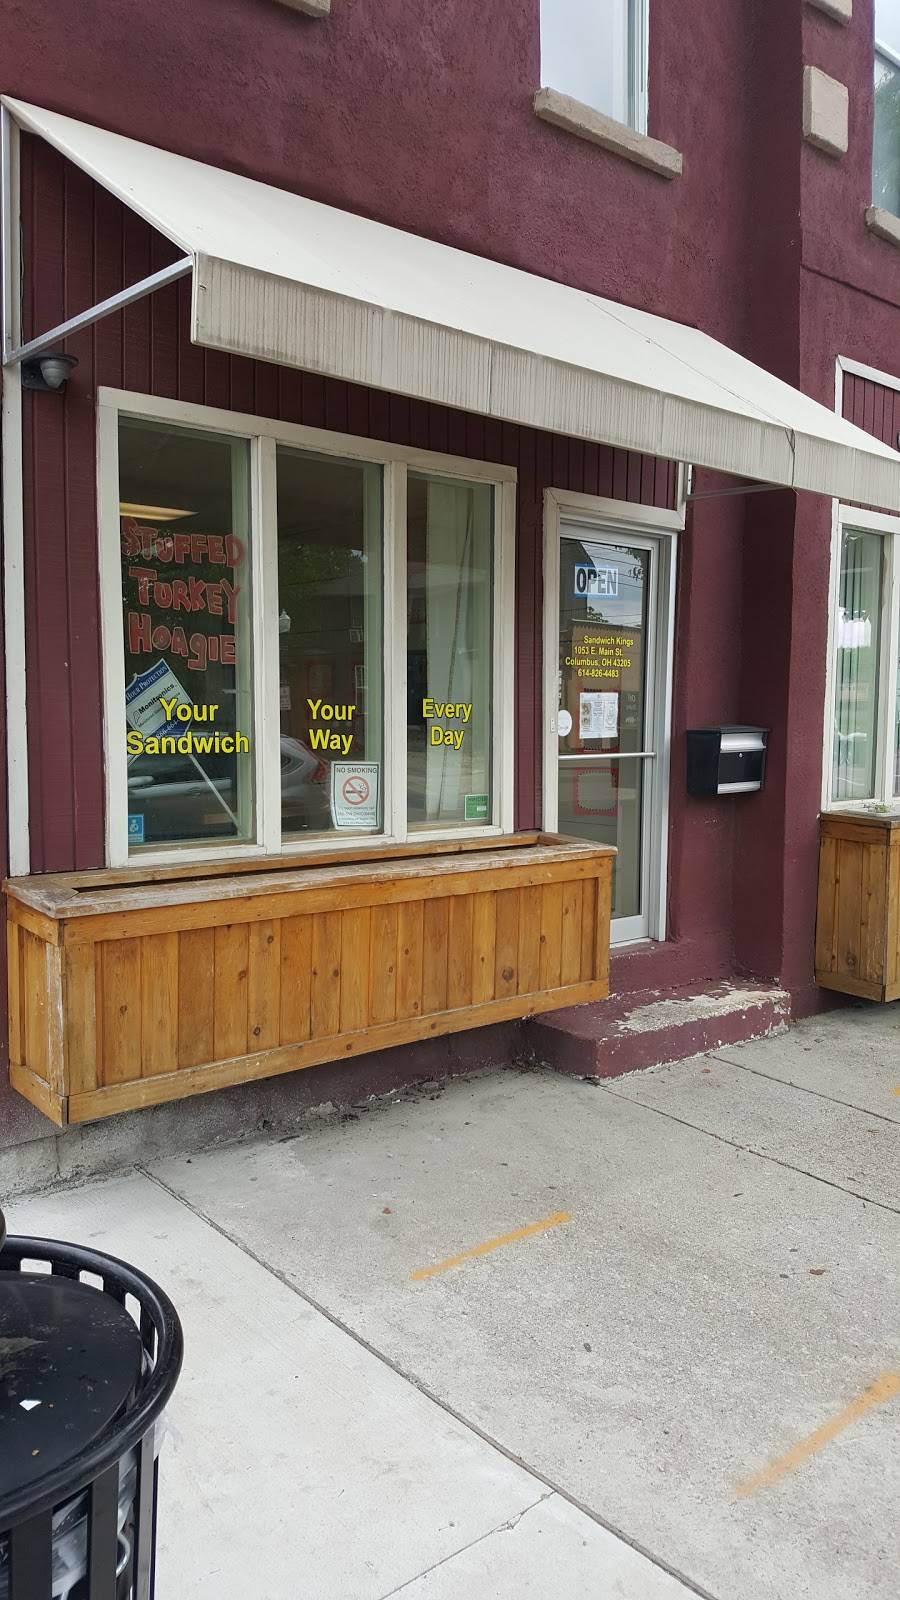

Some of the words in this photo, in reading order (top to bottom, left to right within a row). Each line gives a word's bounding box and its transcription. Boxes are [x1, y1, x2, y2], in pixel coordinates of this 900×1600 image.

[121, 517, 245, 568] STUFFED
[576, 567, 617, 594] OPEN
[128, 566, 240, 624] TURKEY
[128, 612, 236, 671] HOAGIE
[574, 646, 590, 655] 1053
[598, 647, 614, 656] Main
[615, 647, 624, 656] St.
[583, 635, 615, 645] Sandwich
[616, 637, 634, 648] Kings
[565, 656, 601, 667] Columbus,
[601, 658, 612, 667] OH
[612, 659, 632, 667] 43205
[577, 668, 619, 678] 614-826-4483
[138, 665, 169, 690] PROTECTION
[159, 697, 219, 722] Your
[306, 698, 356, 721] Your
[421, 698, 473, 723] Every
[126, 730, 250, 755] Sandwich
[308, 728, 353, 755] Way
[430, 725, 465, 750] Day
[336, 766, 346, 774] NO
